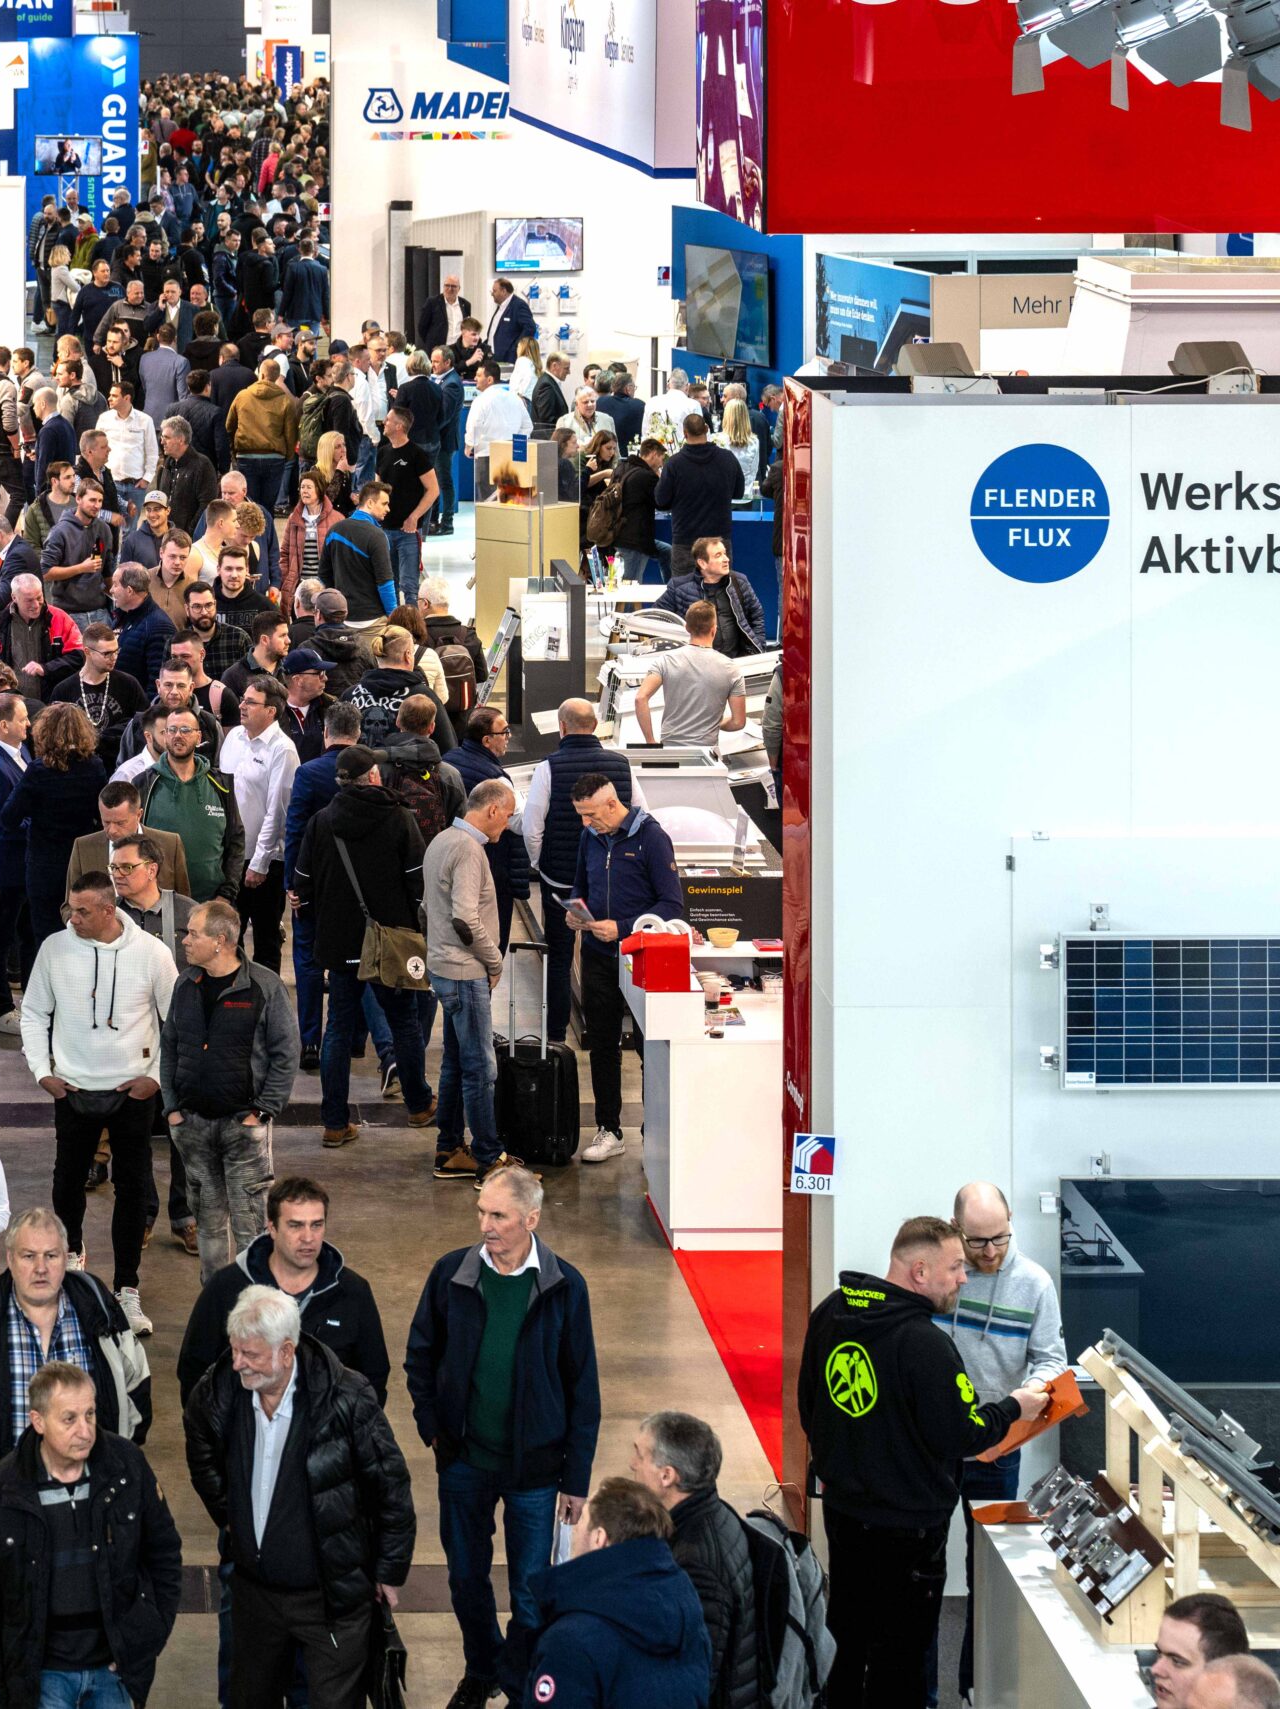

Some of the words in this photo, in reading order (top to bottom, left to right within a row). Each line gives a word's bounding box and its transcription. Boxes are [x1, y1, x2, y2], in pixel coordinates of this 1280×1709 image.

[17, 13, 25, 22] of
[27, 13, 53, 23] guide
[410, 92, 510, 120] MAPEI
[101, 93, 126, 218] GUARD
[87, 176, 95, 209] smart
[1013, 296, 1062, 314] Mehr
[984, 489, 1096, 508] FLENDER
[1008, 528, 1071, 547] FLUX
[687, 885, 743, 896] Gewinnspiel
[795, 1175, 831, 1191] 6.301
